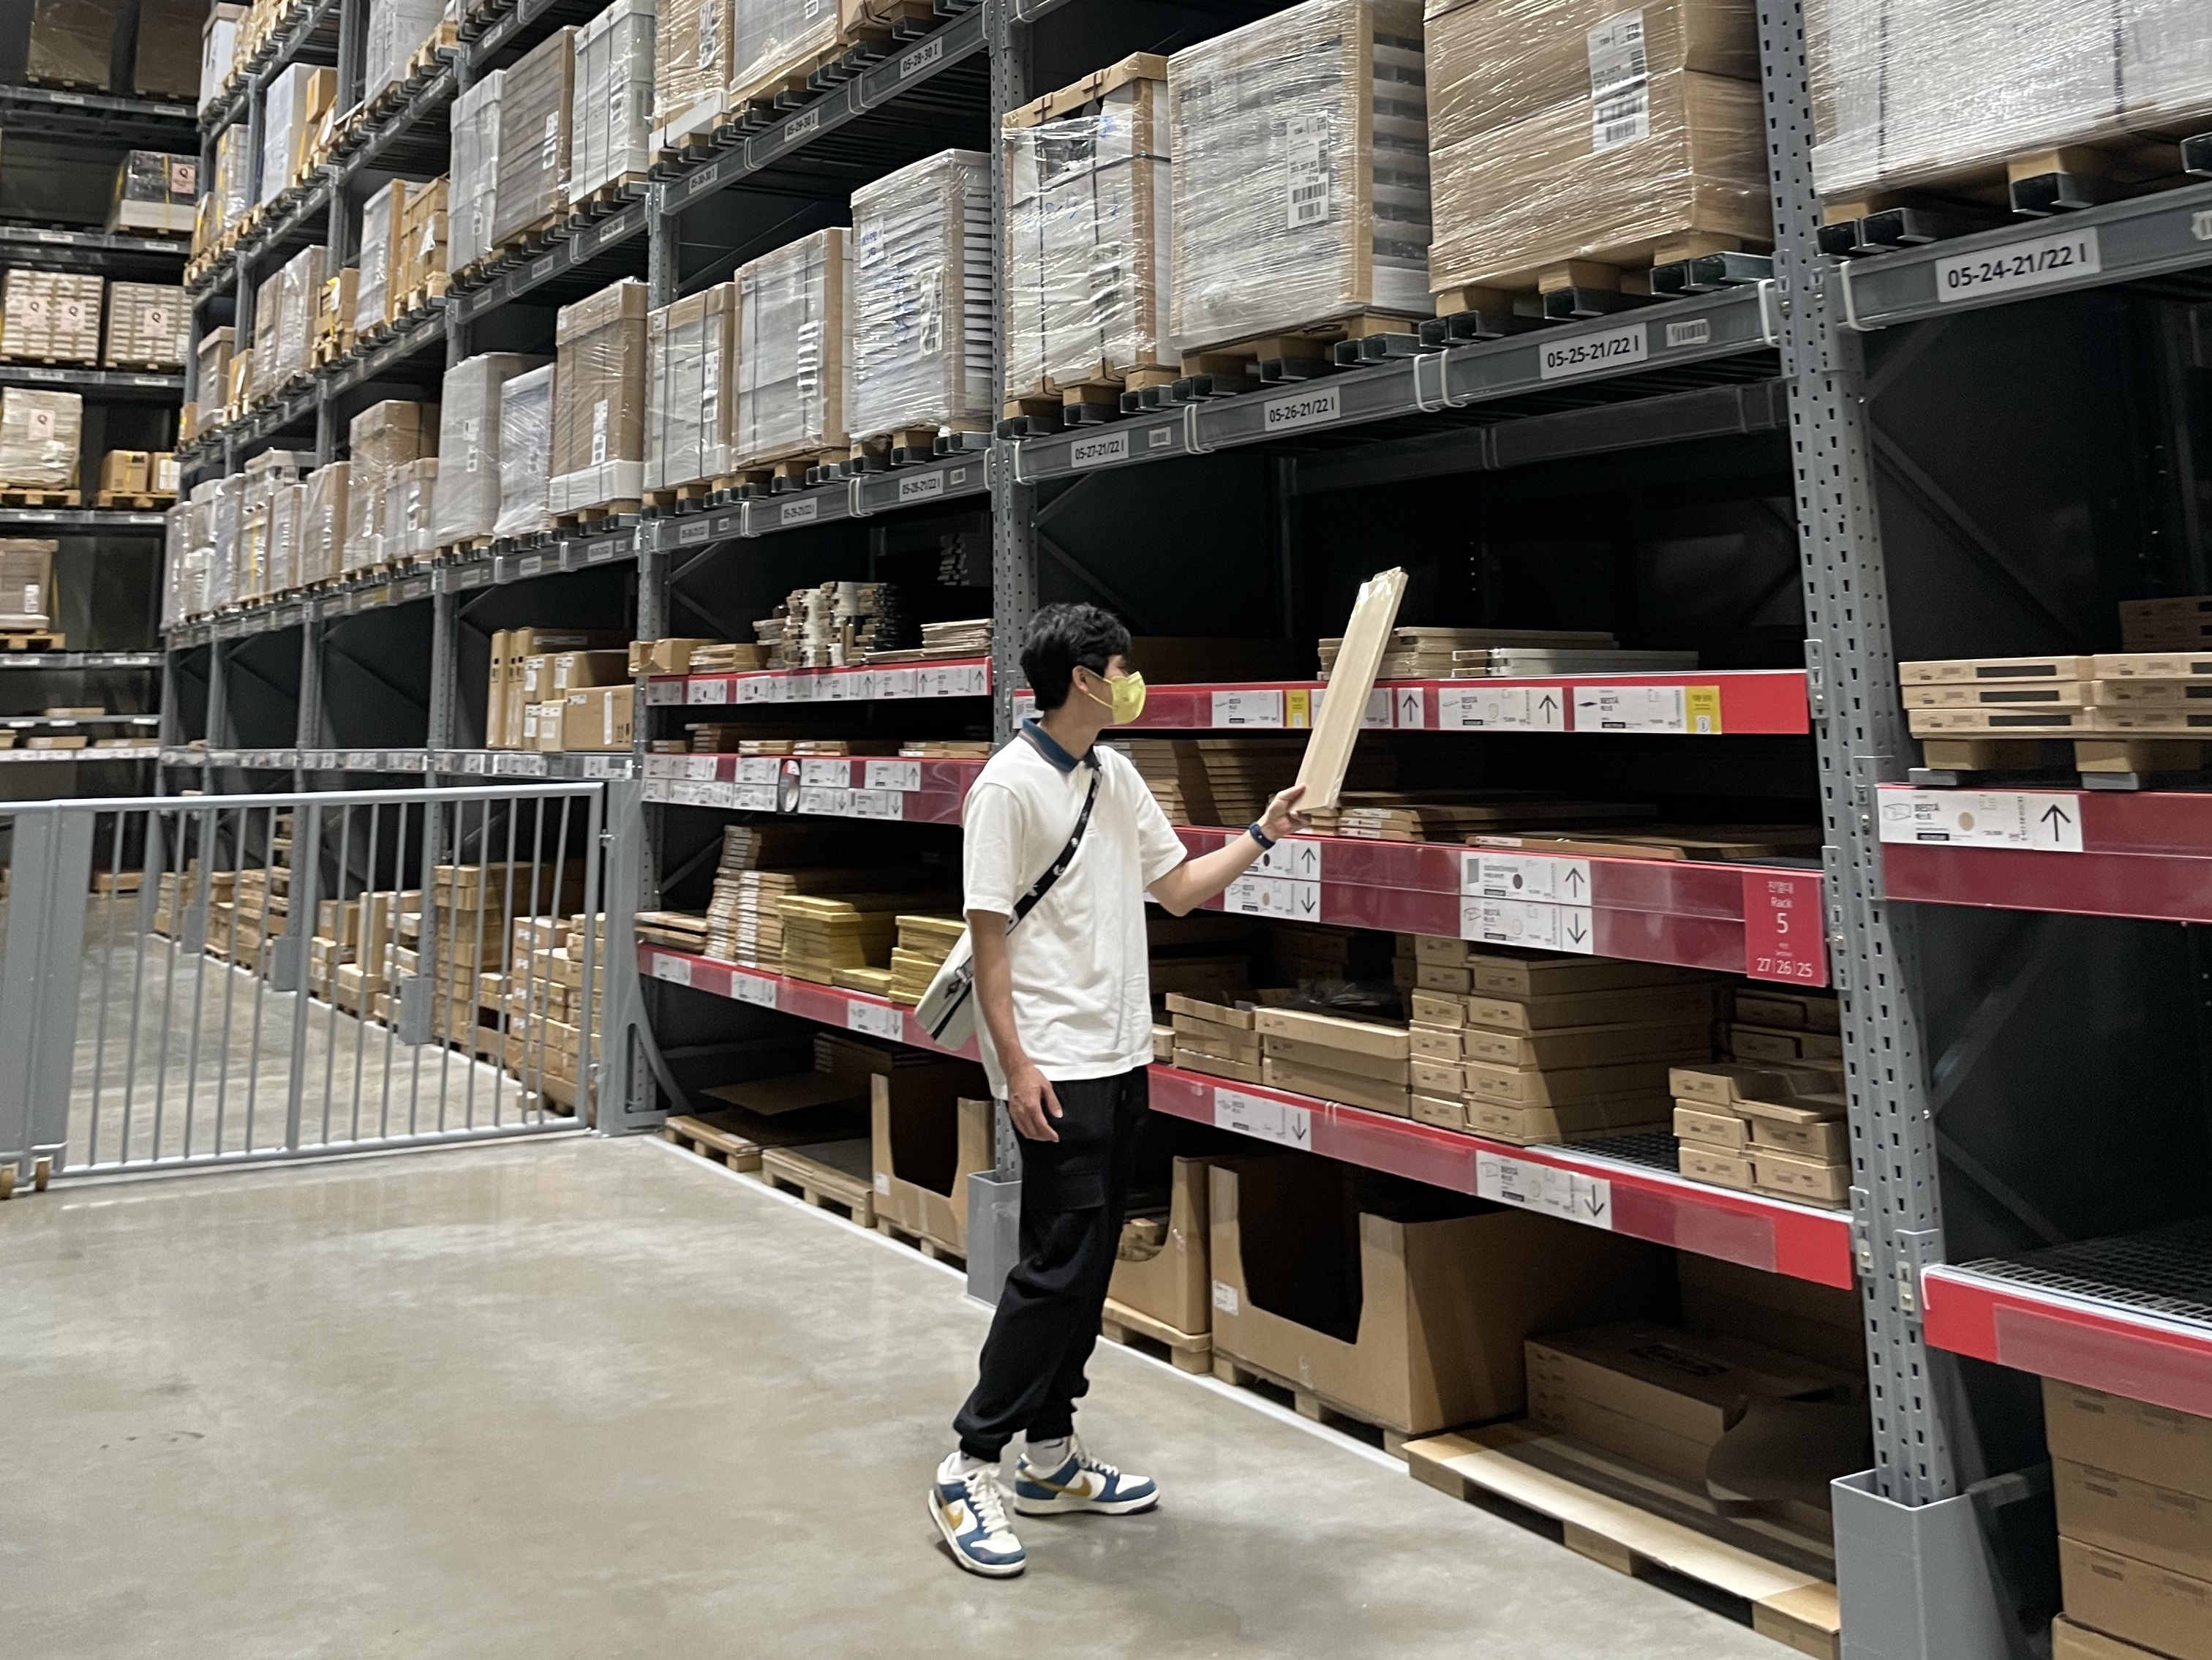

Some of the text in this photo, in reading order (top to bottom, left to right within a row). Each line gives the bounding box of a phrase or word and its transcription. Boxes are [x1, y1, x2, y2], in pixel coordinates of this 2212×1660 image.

[1948, 246, 2074, 288] 05-24-21/22
[1547, 337, 1630, 368] 05-25-21/22
[1269, 398, 1329, 423] 05-26-21/22
[1075, 440, 1120, 460] 05-27-21/22
[1770, 896, 1792, 908] Rack
[1776, 912, 1788, 934] 5
[1756, 957, 1813, 978] 27 26 25
